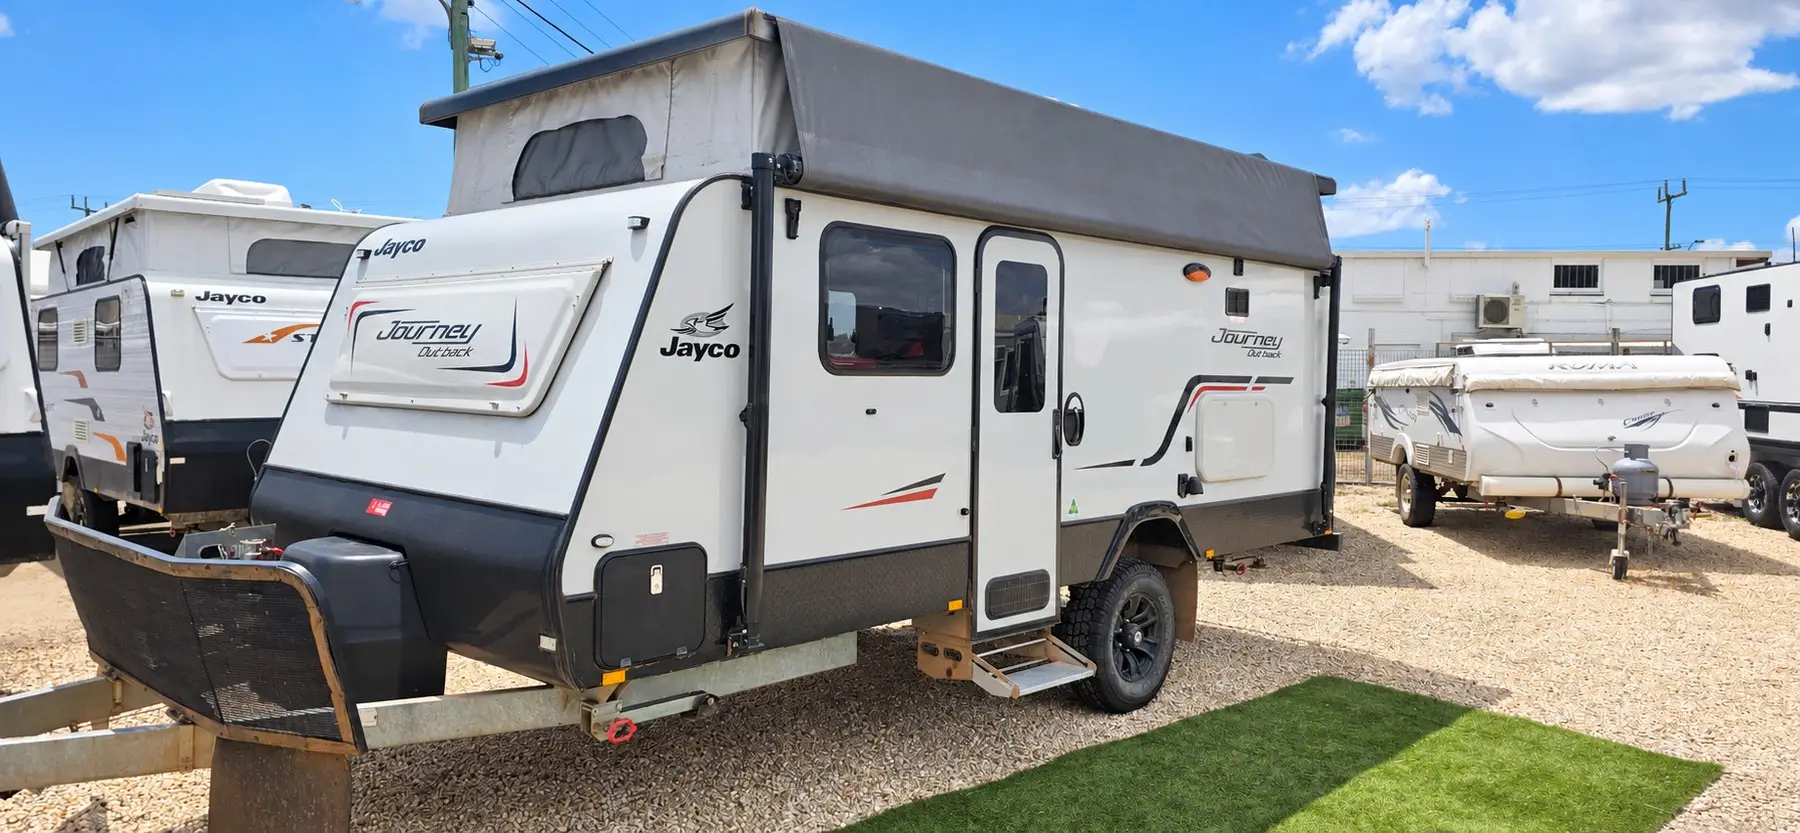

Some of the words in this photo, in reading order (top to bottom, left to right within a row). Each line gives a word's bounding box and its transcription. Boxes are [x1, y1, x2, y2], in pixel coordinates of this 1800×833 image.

[373, 238, 427, 259] Jayco
[195, 290, 267, 305] Jayco
[376, 320, 483, 345] Journey
[1210, 327, 1284, 351] Journey
[659, 336, 741, 362] Jayco
